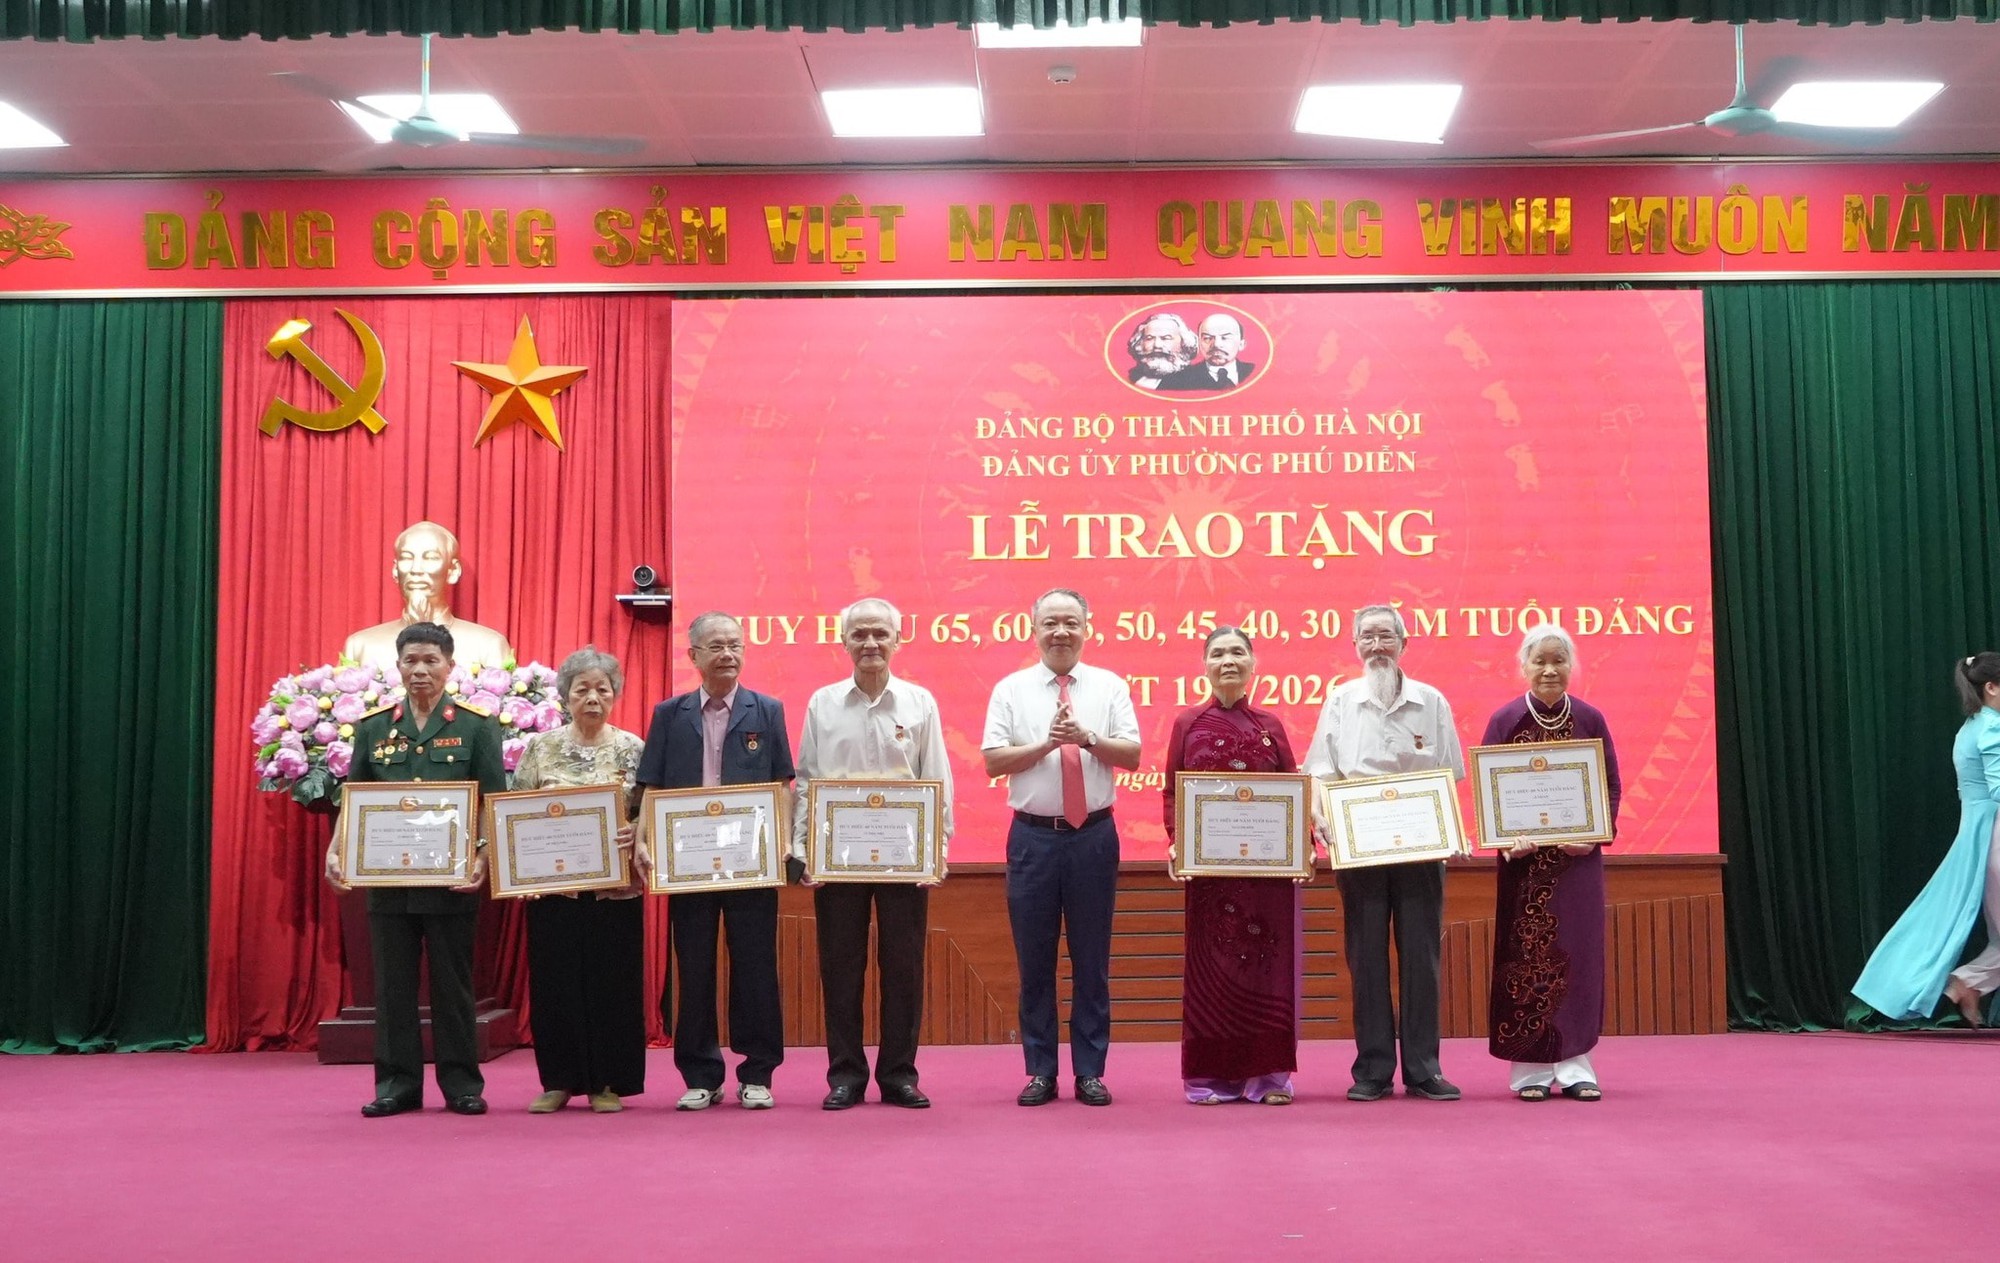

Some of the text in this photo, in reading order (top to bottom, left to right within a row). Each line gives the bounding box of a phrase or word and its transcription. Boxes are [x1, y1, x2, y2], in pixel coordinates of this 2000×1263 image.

[144, 182, 2000, 280] ĐẢNG CỘNG SẢN VIỆT NAM QUANG VINH MUÔN NĂM
[975, 407, 1423, 444] ĐẢNG BỘ THÀNH PHỐ HÀ NỘI
[982, 445, 1417, 477] ĐẢNG ỦY PHƯỜNG PHÚ DIỄN
[967, 499, 1438, 570] LỄ TRAO TẶNG
[734, 615, 804, 646] UY
[930, 612, 981, 649] 65,
[1116, 611, 1167, 647] 50,
[1239, 609, 1290, 646] 40,
[1300, 609, 1341, 639] 30
[1575, 597, 1695, 636] ĐẢNG
